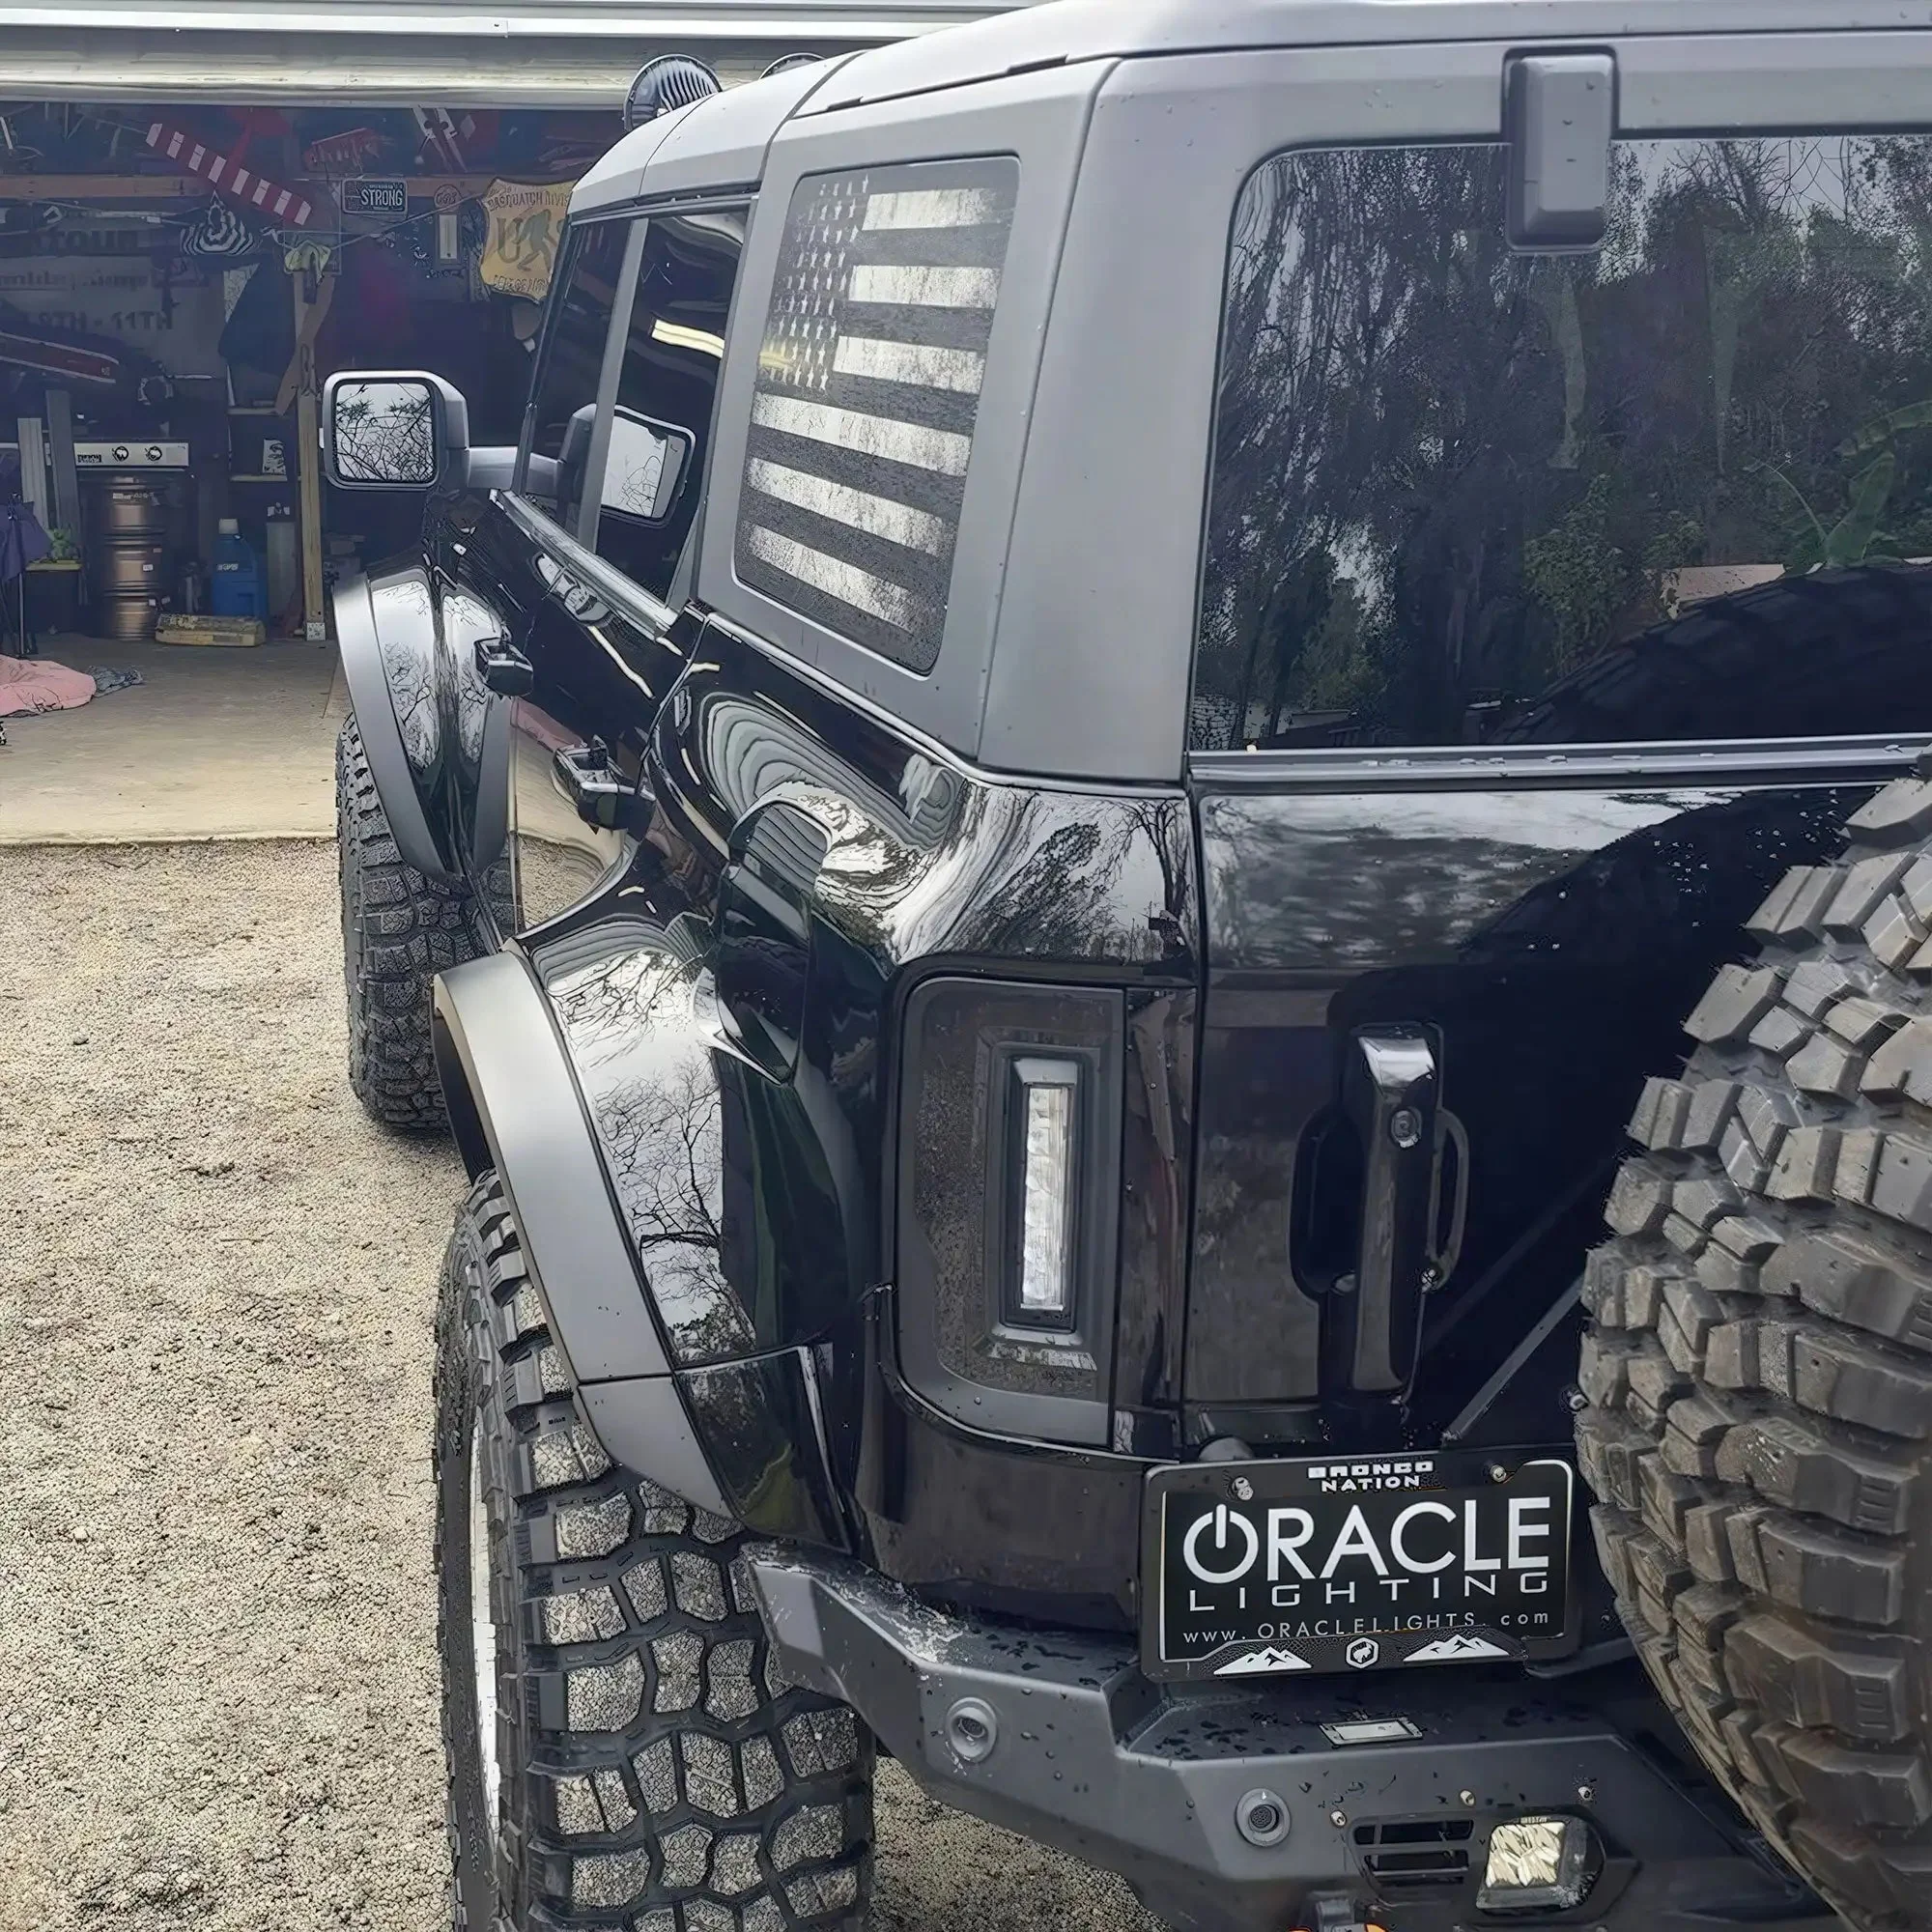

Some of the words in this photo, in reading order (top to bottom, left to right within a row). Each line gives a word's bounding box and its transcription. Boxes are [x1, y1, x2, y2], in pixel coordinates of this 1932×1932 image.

[360, 188, 404, 207] STRONG
[1321, 1475, 1420, 1492] NATION
[1182, 1496, 1550, 1584] ORACLE
[1189, 1571, 1548, 1612] LIGHTING
